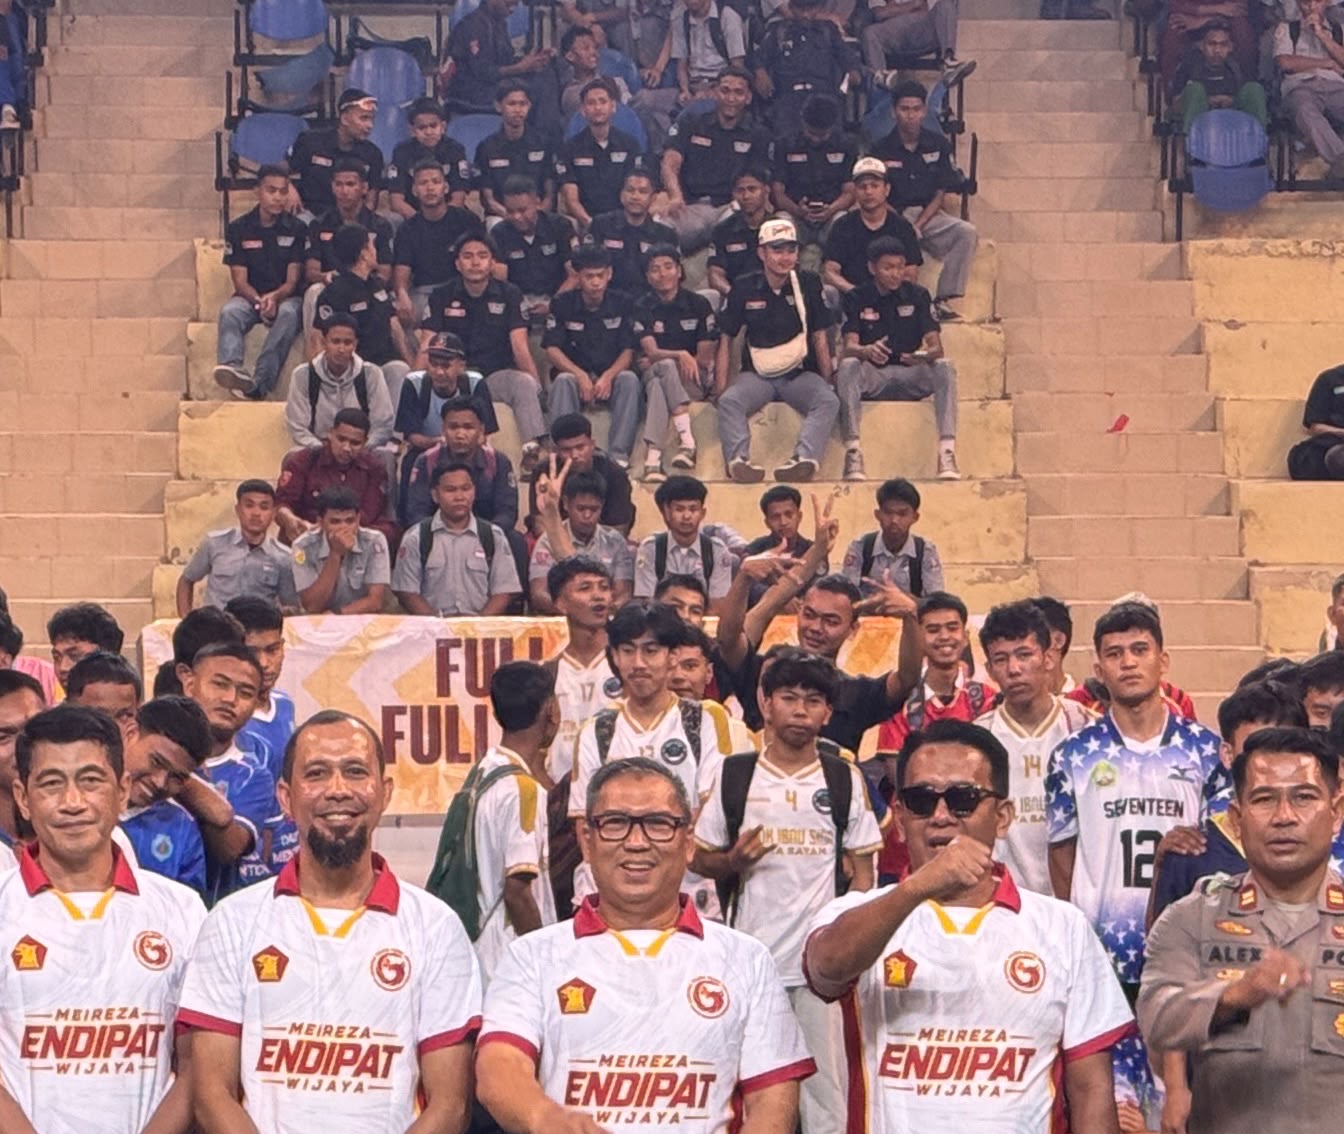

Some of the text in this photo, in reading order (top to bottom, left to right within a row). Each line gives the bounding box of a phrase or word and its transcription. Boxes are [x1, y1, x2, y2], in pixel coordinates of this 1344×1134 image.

[1023, 754, 1042, 778] 14
[1103, 797, 1185, 818] SEVENTEEN
[1120, 829, 1165, 889] 12
[1208, 945, 1262, 963] ALEX
[55, 1007, 140, 1022] MEIREZA
[288, 1022, 371, 1039] MEIREZA
[918, 1027, 1008, 1042] MEIREZA
[20, 1024, 166, 1060] ENDIPAT
[255, 1038, 405, 1079] ENDIPAT
[598, 1054, 689, 1068] MEIREZA
[878, 1042, 1038, 1082] ENDIPAT
[56, 1062, 136, 1075] WIJAYA
[286, 1077, 365, 1094] WIJAYA
[564, 1070, 717, 1109] ENDIPAT
[916, 1084, 1001, 1097] WIJAYA
[596, 1111, 681, 1125] WIJAYA
